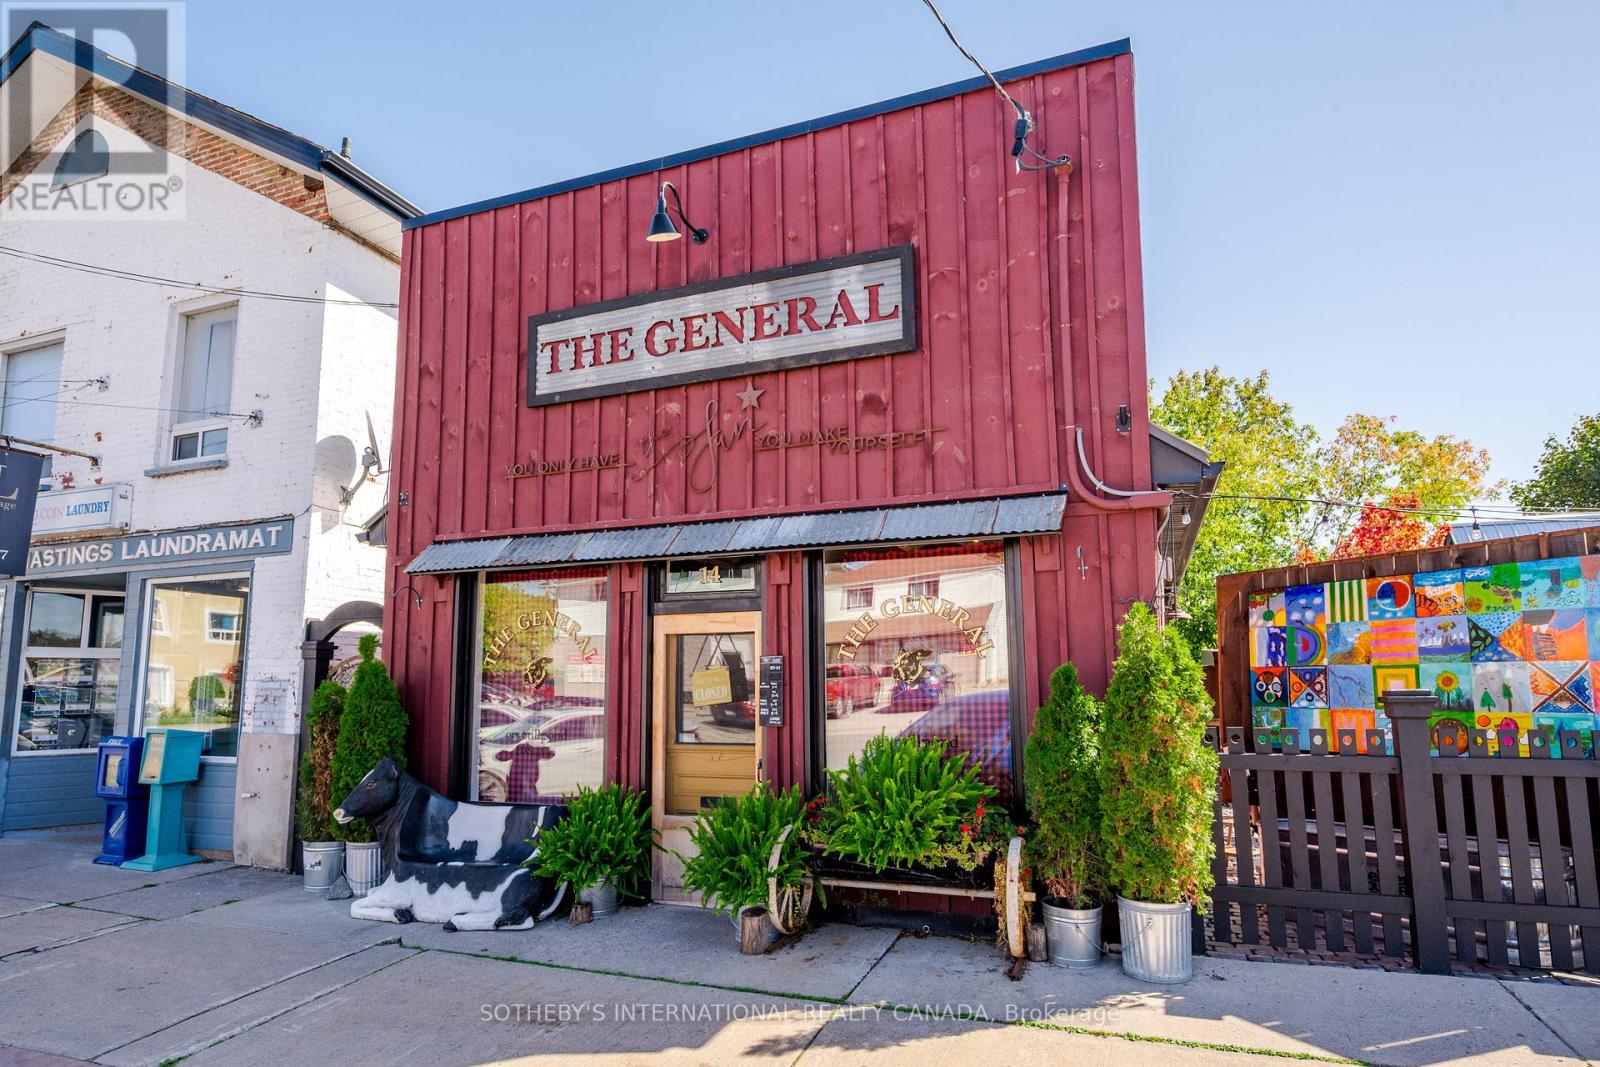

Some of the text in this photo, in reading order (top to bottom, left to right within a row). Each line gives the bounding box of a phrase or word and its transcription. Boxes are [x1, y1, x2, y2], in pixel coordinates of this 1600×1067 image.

[540, 282, 900, 375] THE GENERAL
[756, 427, 849, 449] YOU MAKE
[504, 454, 620, 478] YOU ONLY HAVE
[66, 500, 110, 517] LAUNDRY
[121, 526, 283, 561] LAUNDRAMAT
[699, 565, 722, 585] 14
[483, 609, 598, 666] THE GENERAL
[836, 594, 995, 662] THE GENERAL
